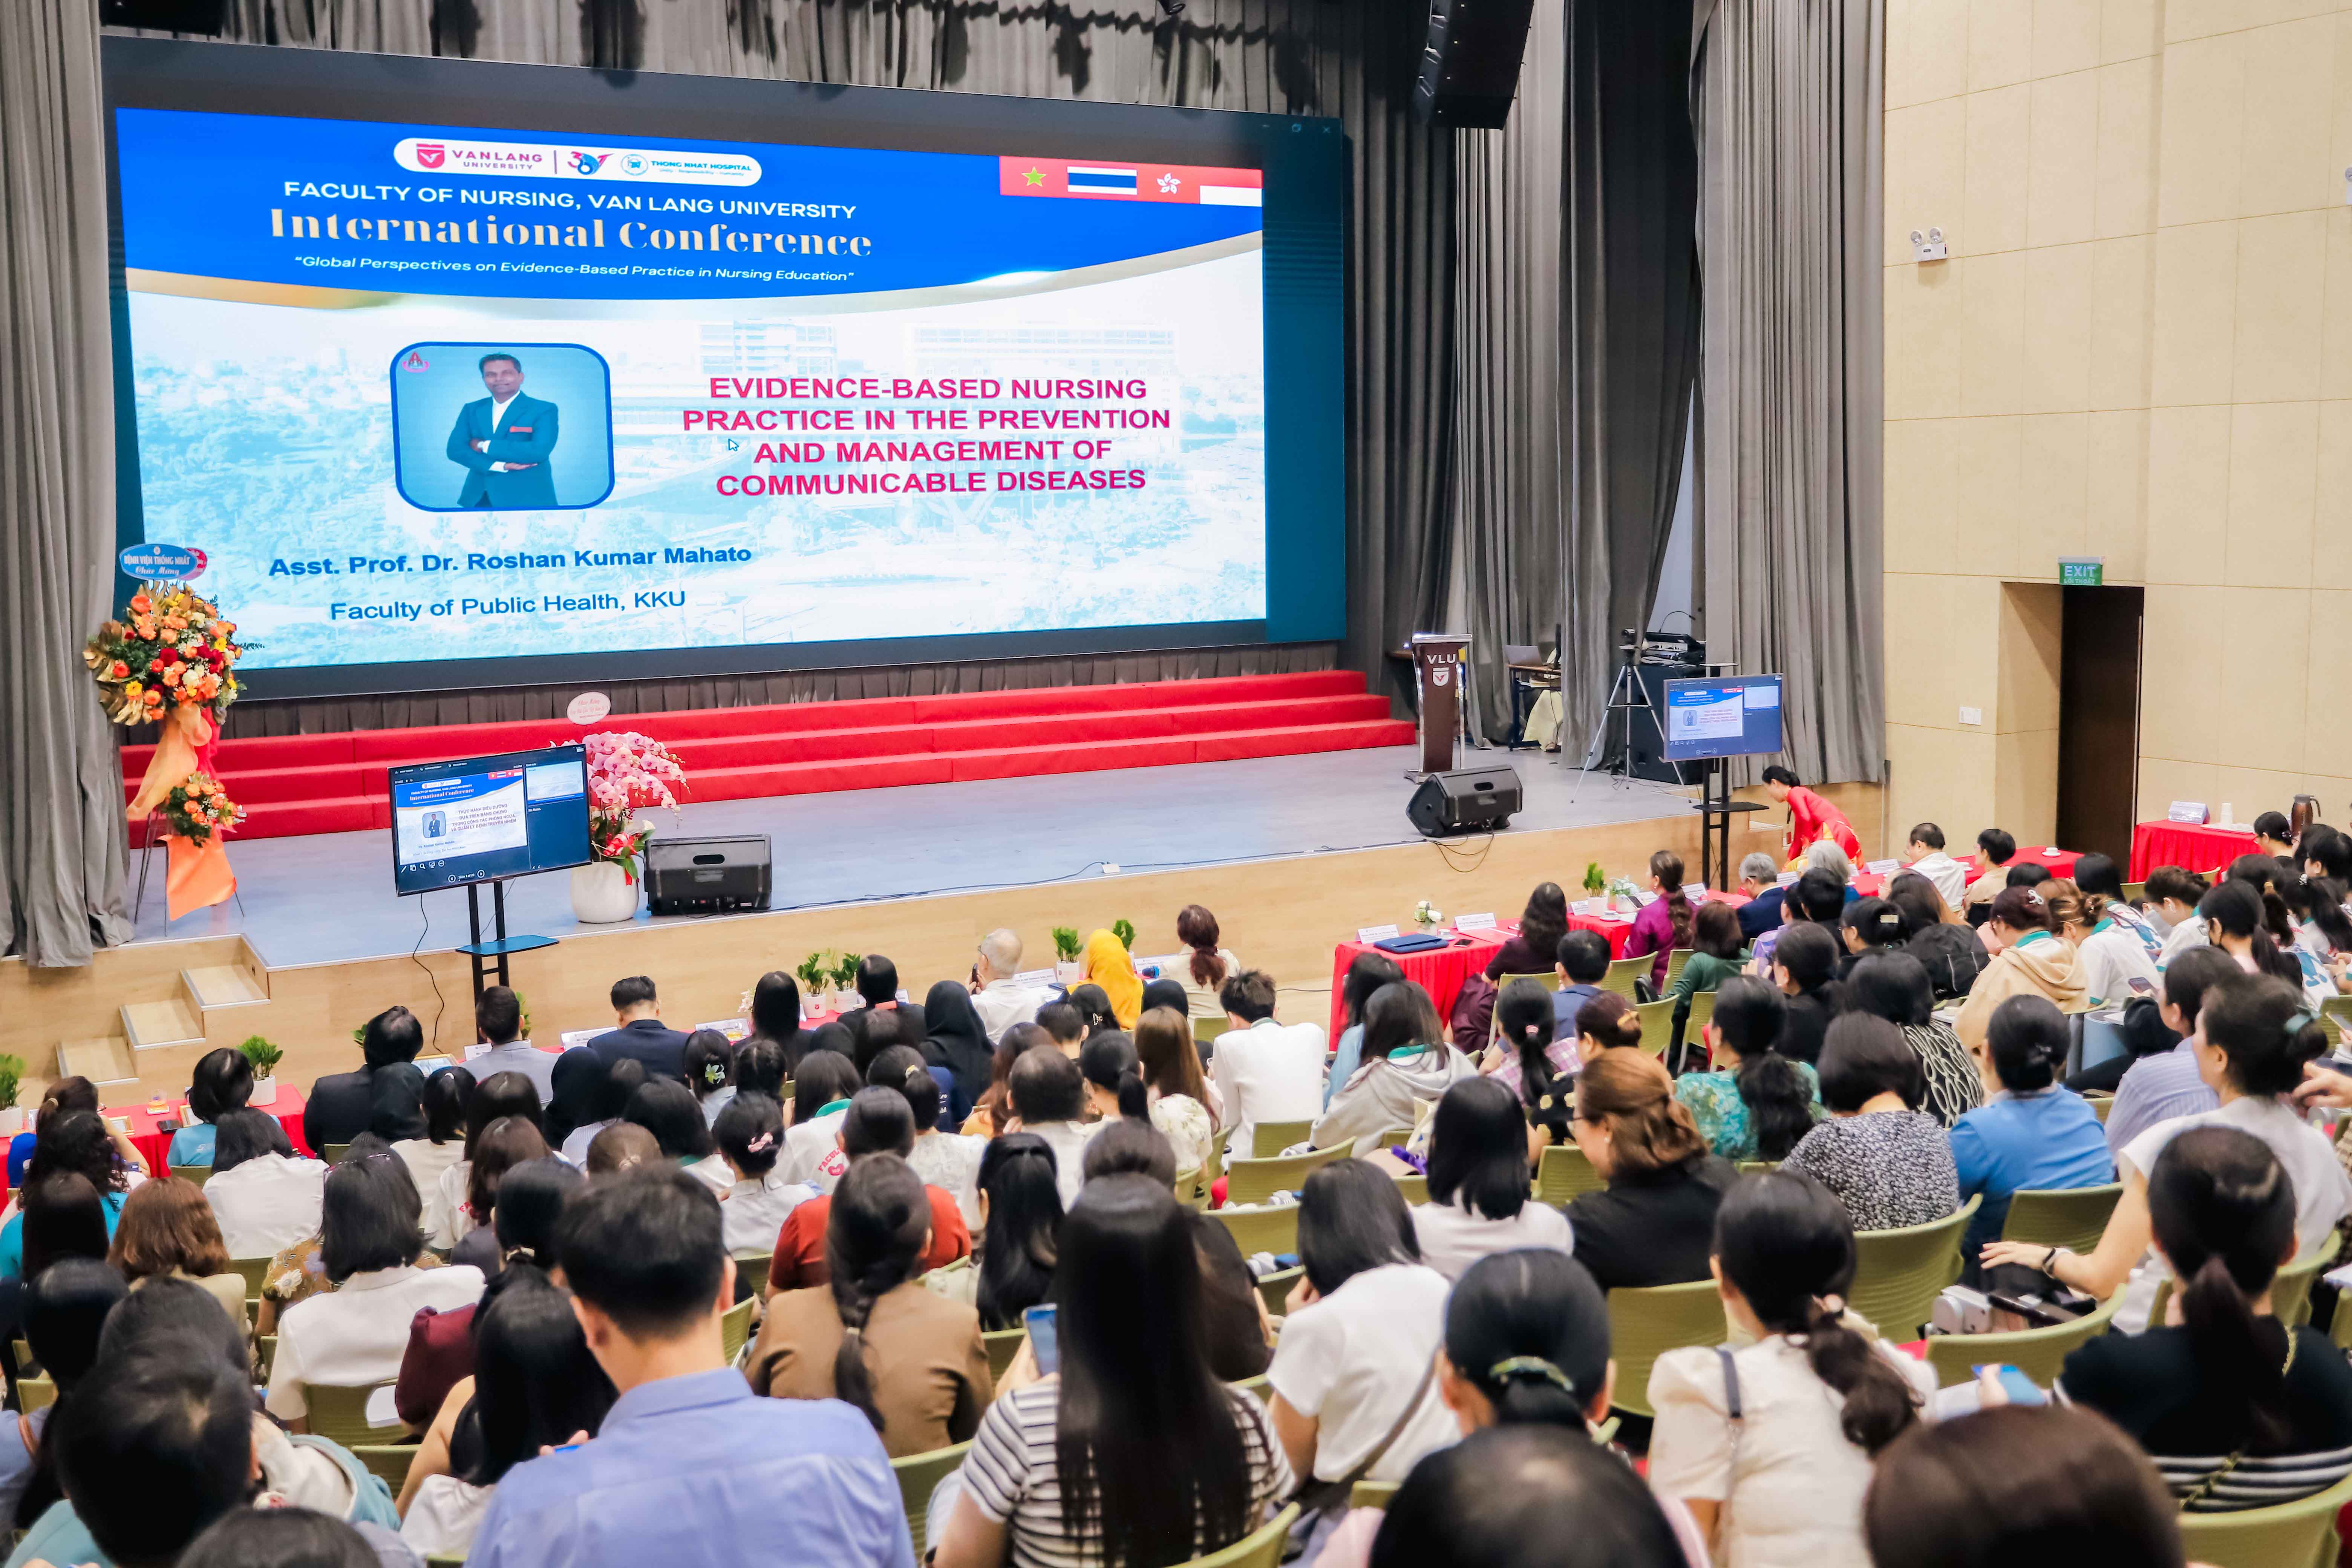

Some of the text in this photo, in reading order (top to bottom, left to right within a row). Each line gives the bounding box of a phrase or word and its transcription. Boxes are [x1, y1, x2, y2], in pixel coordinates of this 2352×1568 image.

[463, 161, 533, 170] UNIVERSITY
[285, 182, 856, 219] FACULTY OF NURSING, VAN LANG UNIVERSITY
[271, 208, 871, 256] International Conference
[360, 258, 471, 272] Perspectives
[501, 262, 628, 275] Evidence-Based
[632, 266, 694, 277] Practice
[698, 268, 712, 277] in
[716, 268, 772, 282] Nursing
[710, 378, 1146, 399] EVIDENCE-BASED NURSING
[684, 409, 1170, 430] PRACTICE IN THE PREVENTION
[754, 440, 1112, 463] AND MANAGEMENT OF
[717, 470, 1146, 496] COMMUNICABLE DISEASES
[268, 547, 752, 576] Asst. Prof. Dr. Roshan Kumar Mahato
[2064, 565, 2096, 577] EXIT
[331, 591, 685, 622] Faculty of Public Health, KKU
[1426, 654, 1456, 664] VLU
[410, 792, 444, 801] International
[818, 1148, 841, 1172] FACUL
